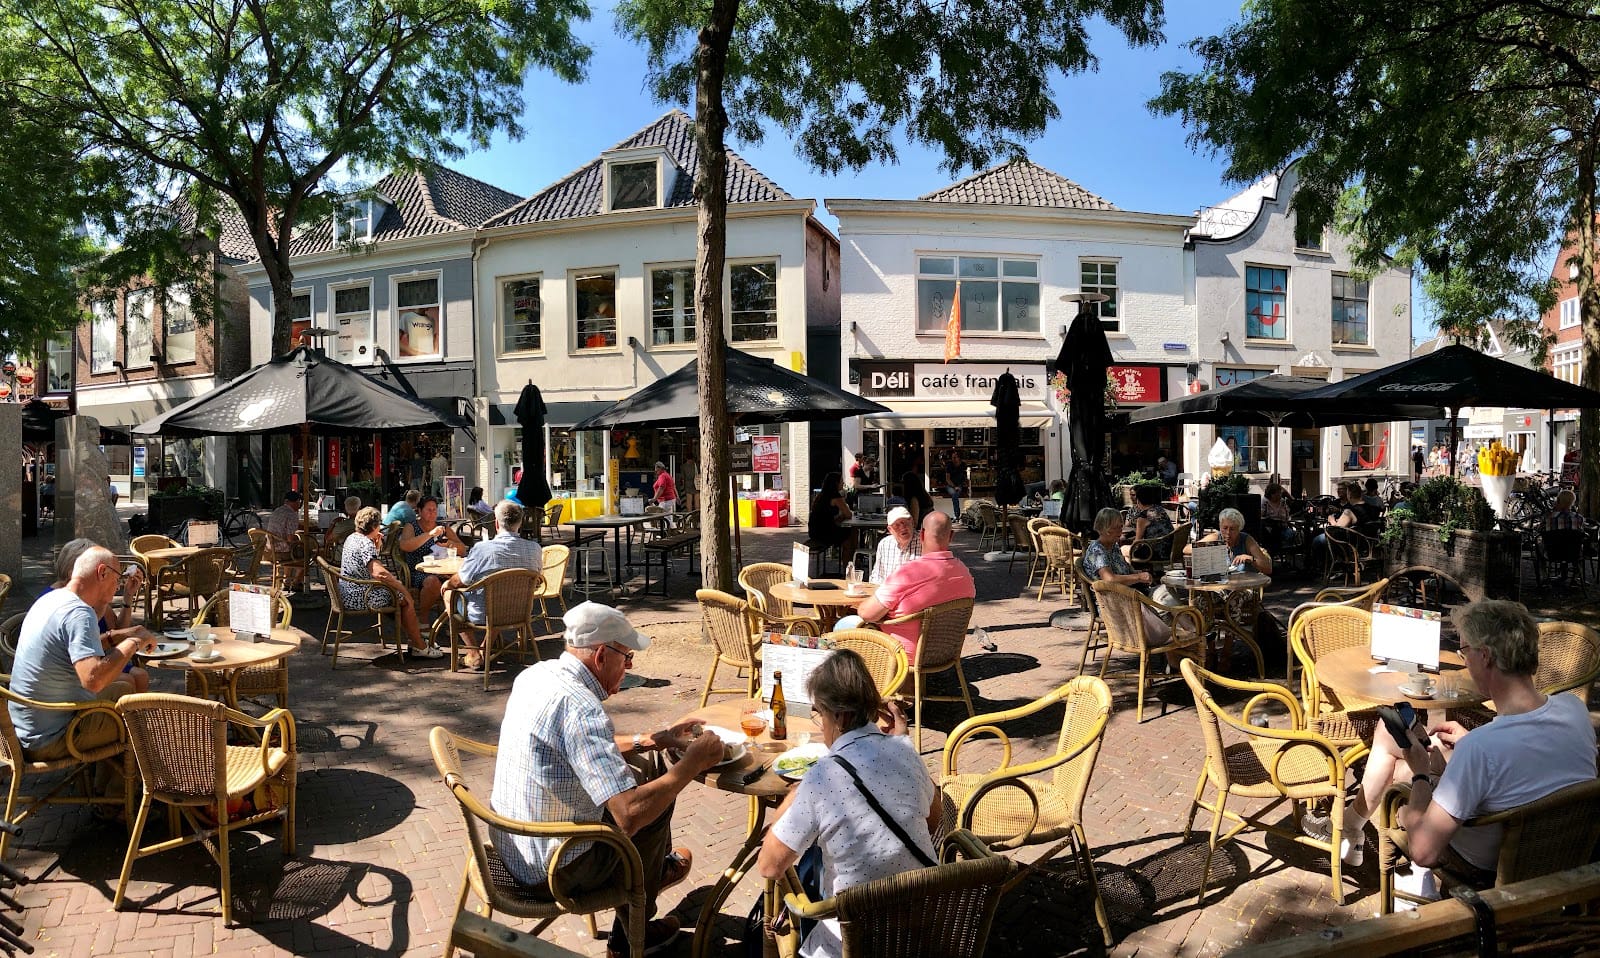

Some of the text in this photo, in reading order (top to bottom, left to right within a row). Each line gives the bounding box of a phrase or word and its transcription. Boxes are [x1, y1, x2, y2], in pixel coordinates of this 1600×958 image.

[871, 371, 1035, 389] Déli café franais
